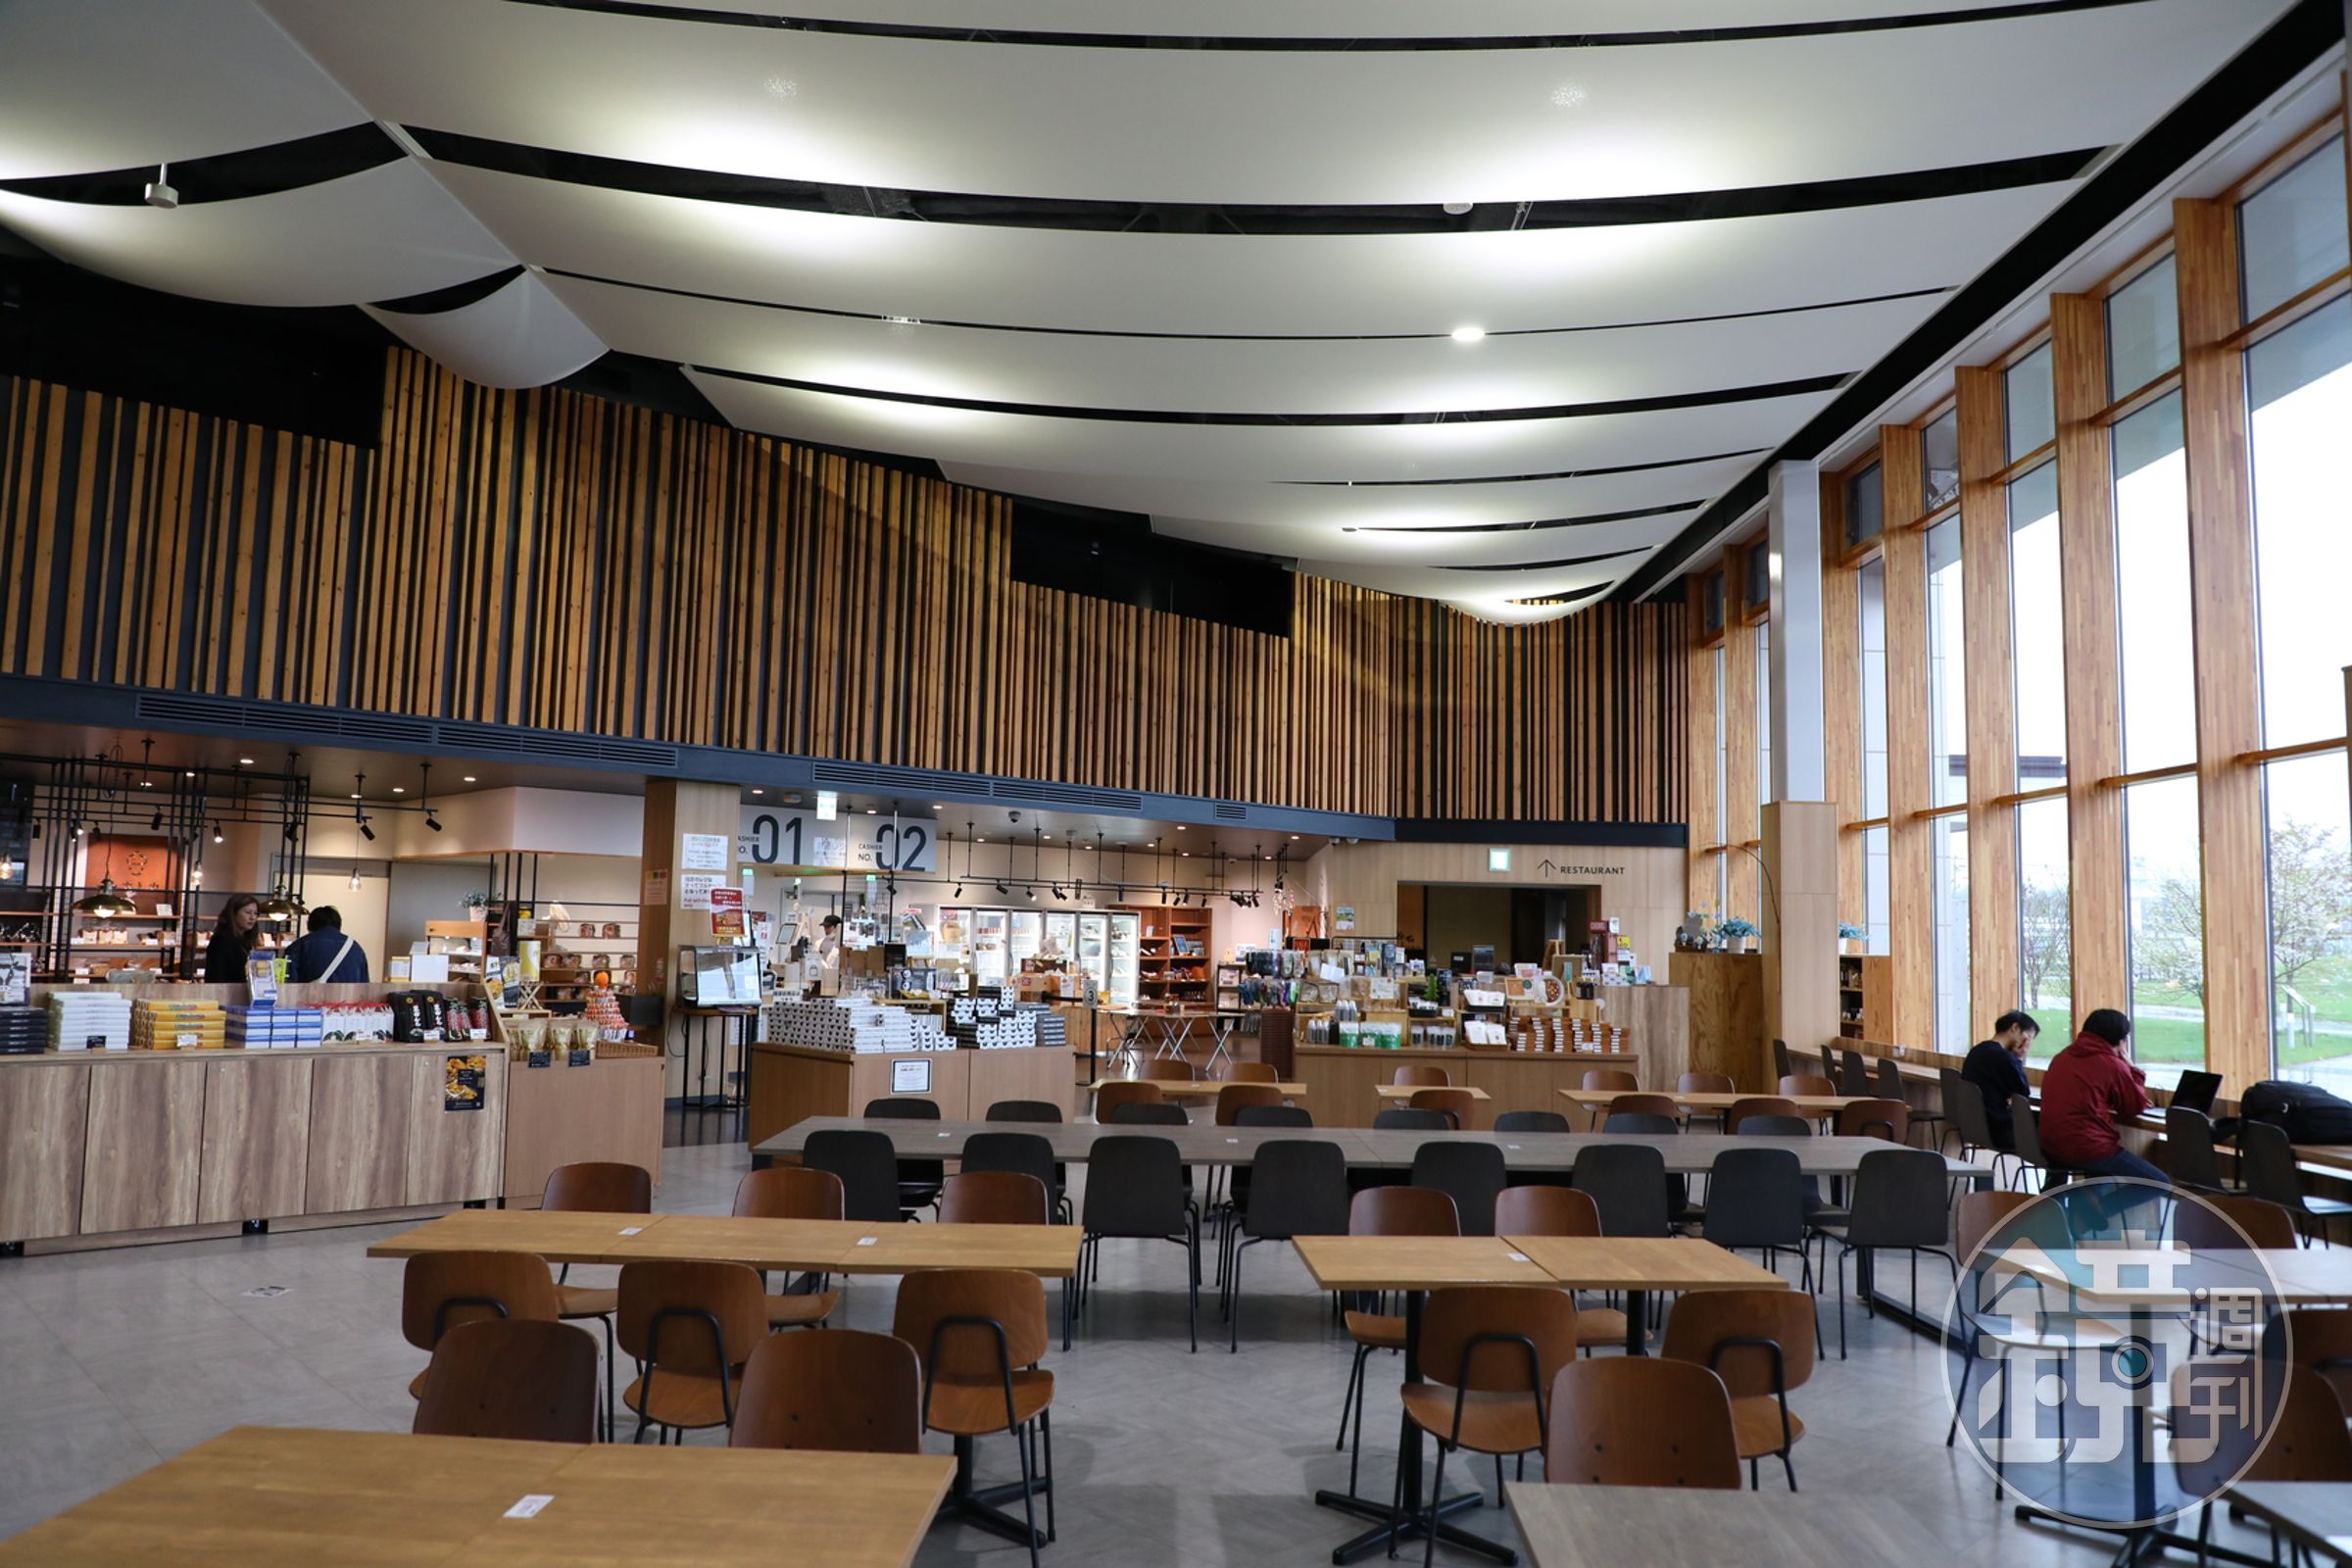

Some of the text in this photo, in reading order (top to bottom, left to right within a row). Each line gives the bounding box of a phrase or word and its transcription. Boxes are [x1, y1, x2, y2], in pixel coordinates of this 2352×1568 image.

[752, 814, 803, 865] 01
[876, 823, 926, 871] 02
[858, 853, 872, 861] NO.
[1560, 866, 1625, 875] RESTAURANT
[1088, 991, 1094, 1002] 3
